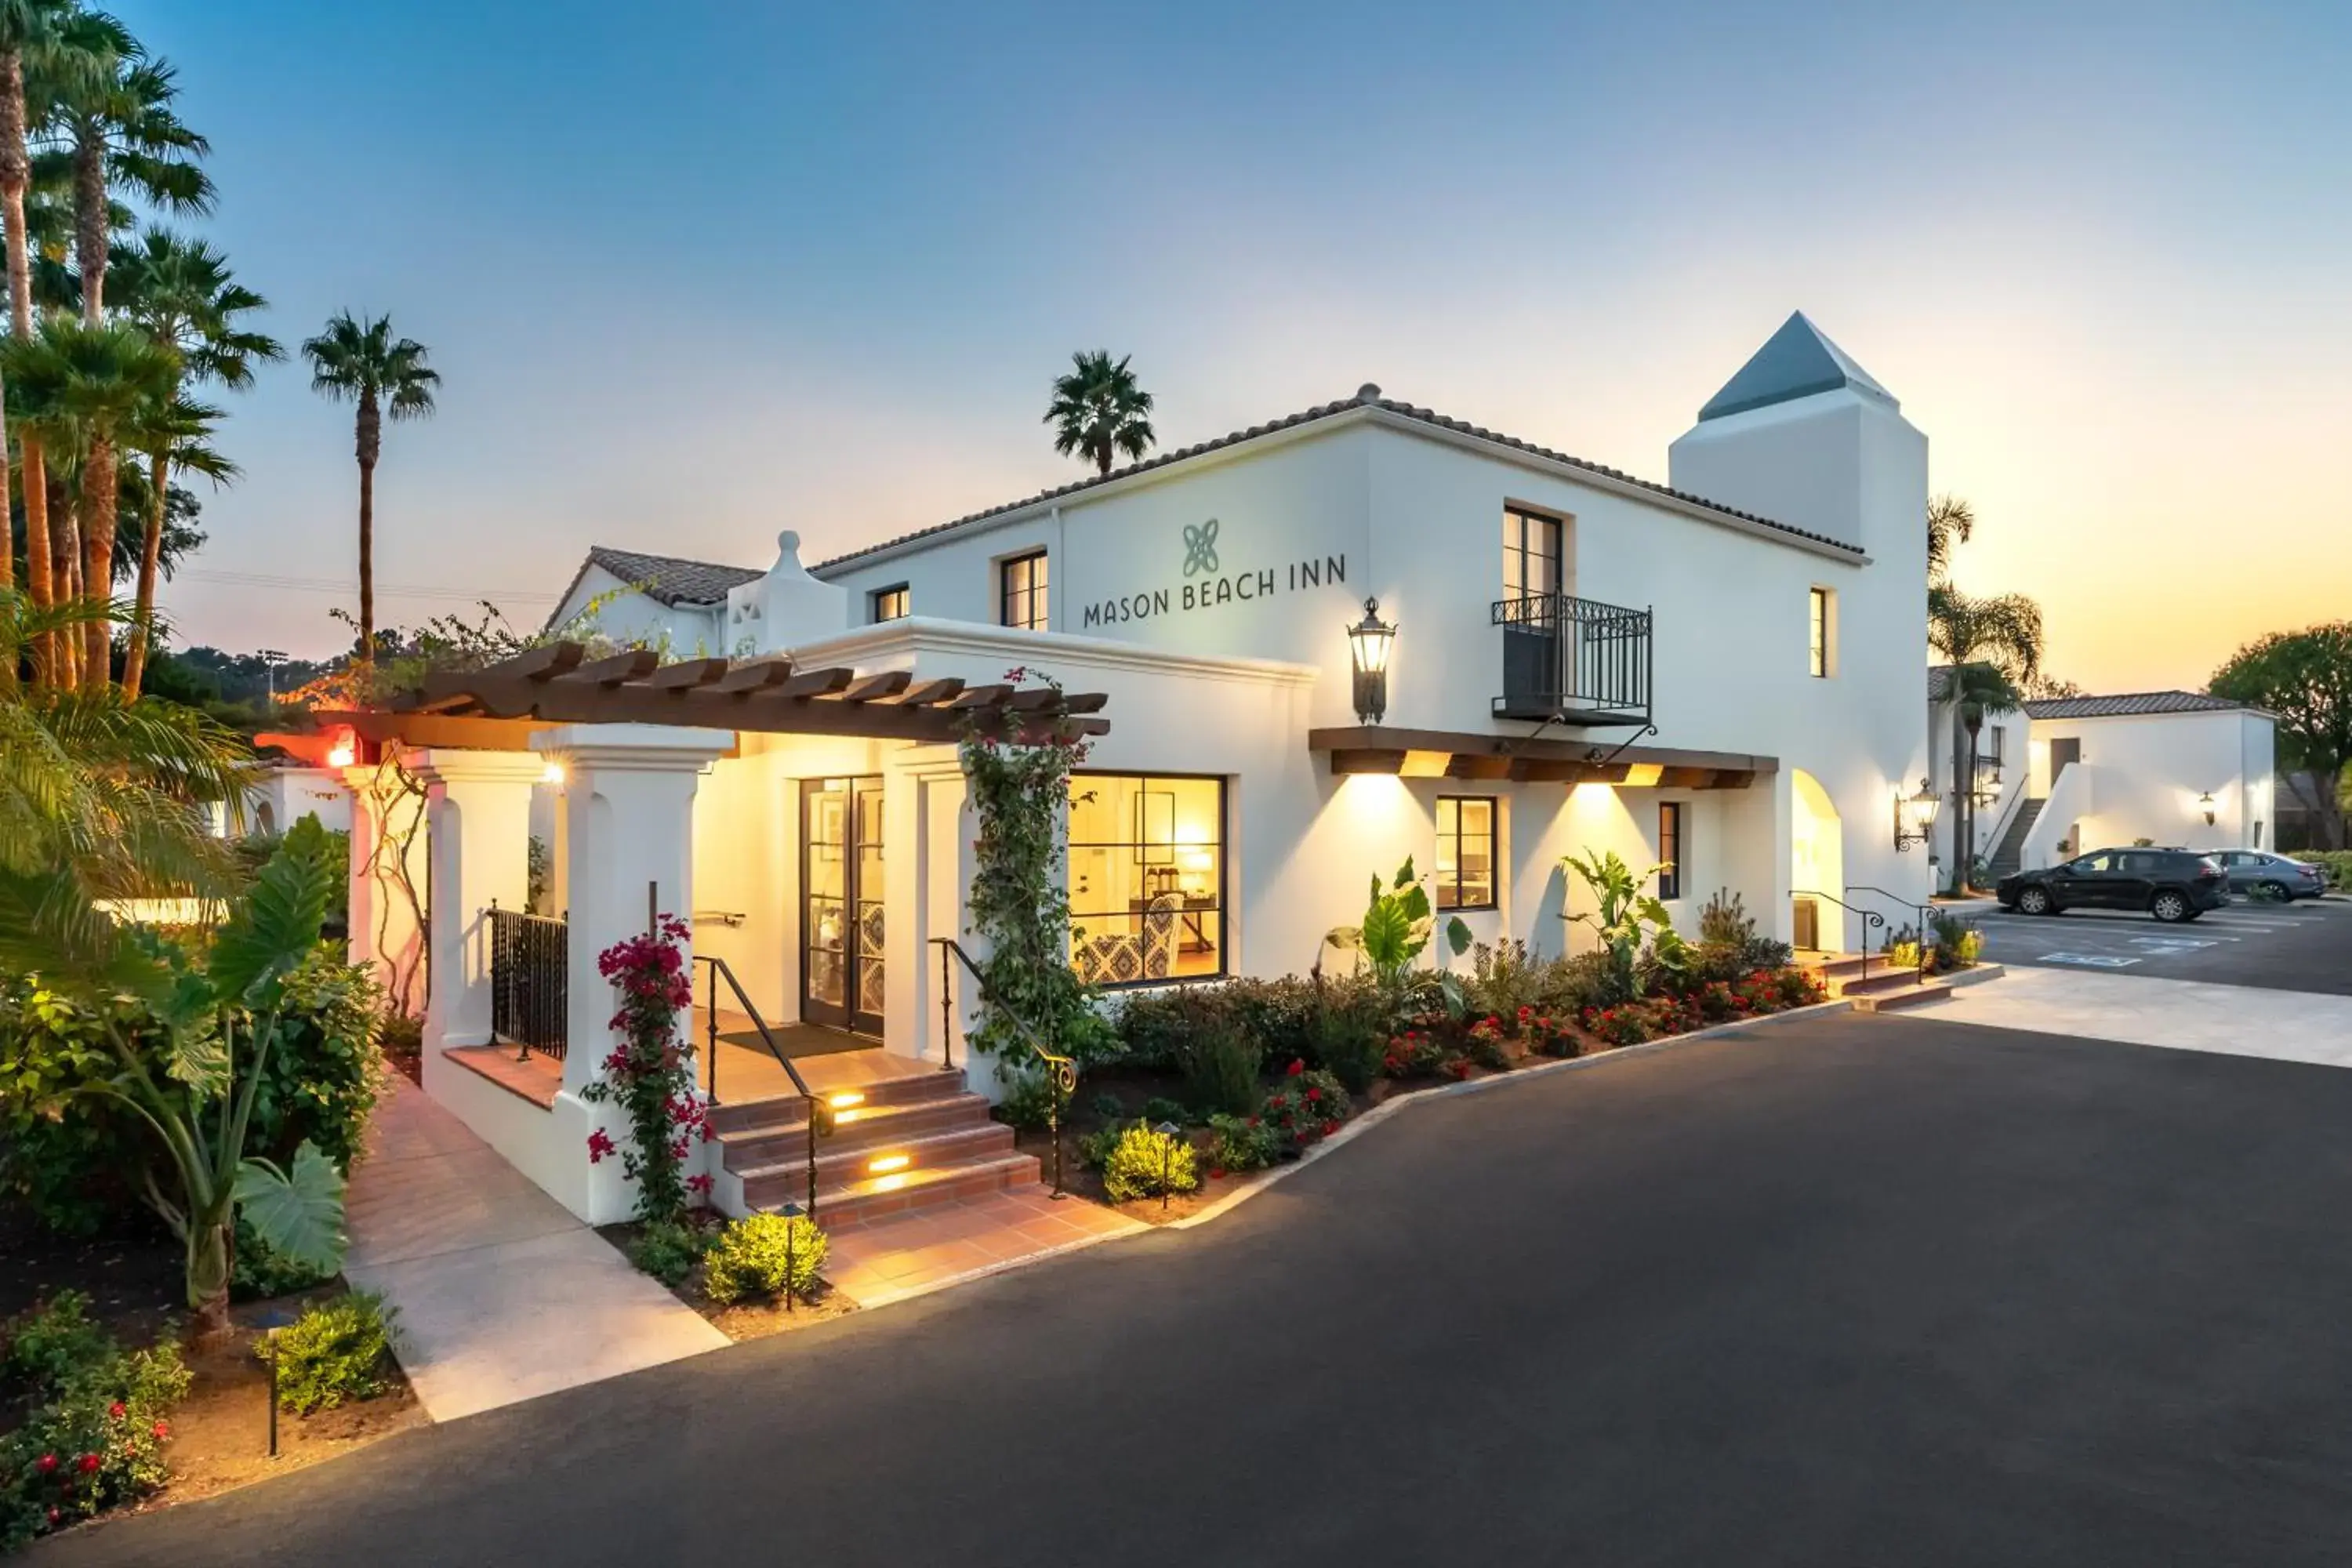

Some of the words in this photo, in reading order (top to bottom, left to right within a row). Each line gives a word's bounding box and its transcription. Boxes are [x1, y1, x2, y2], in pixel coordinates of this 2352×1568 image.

[1083, 589, 1169, 629] MASON
[1182, 568, 1275, 611] BEACH
[1290, 554, 1345, 591] INN
